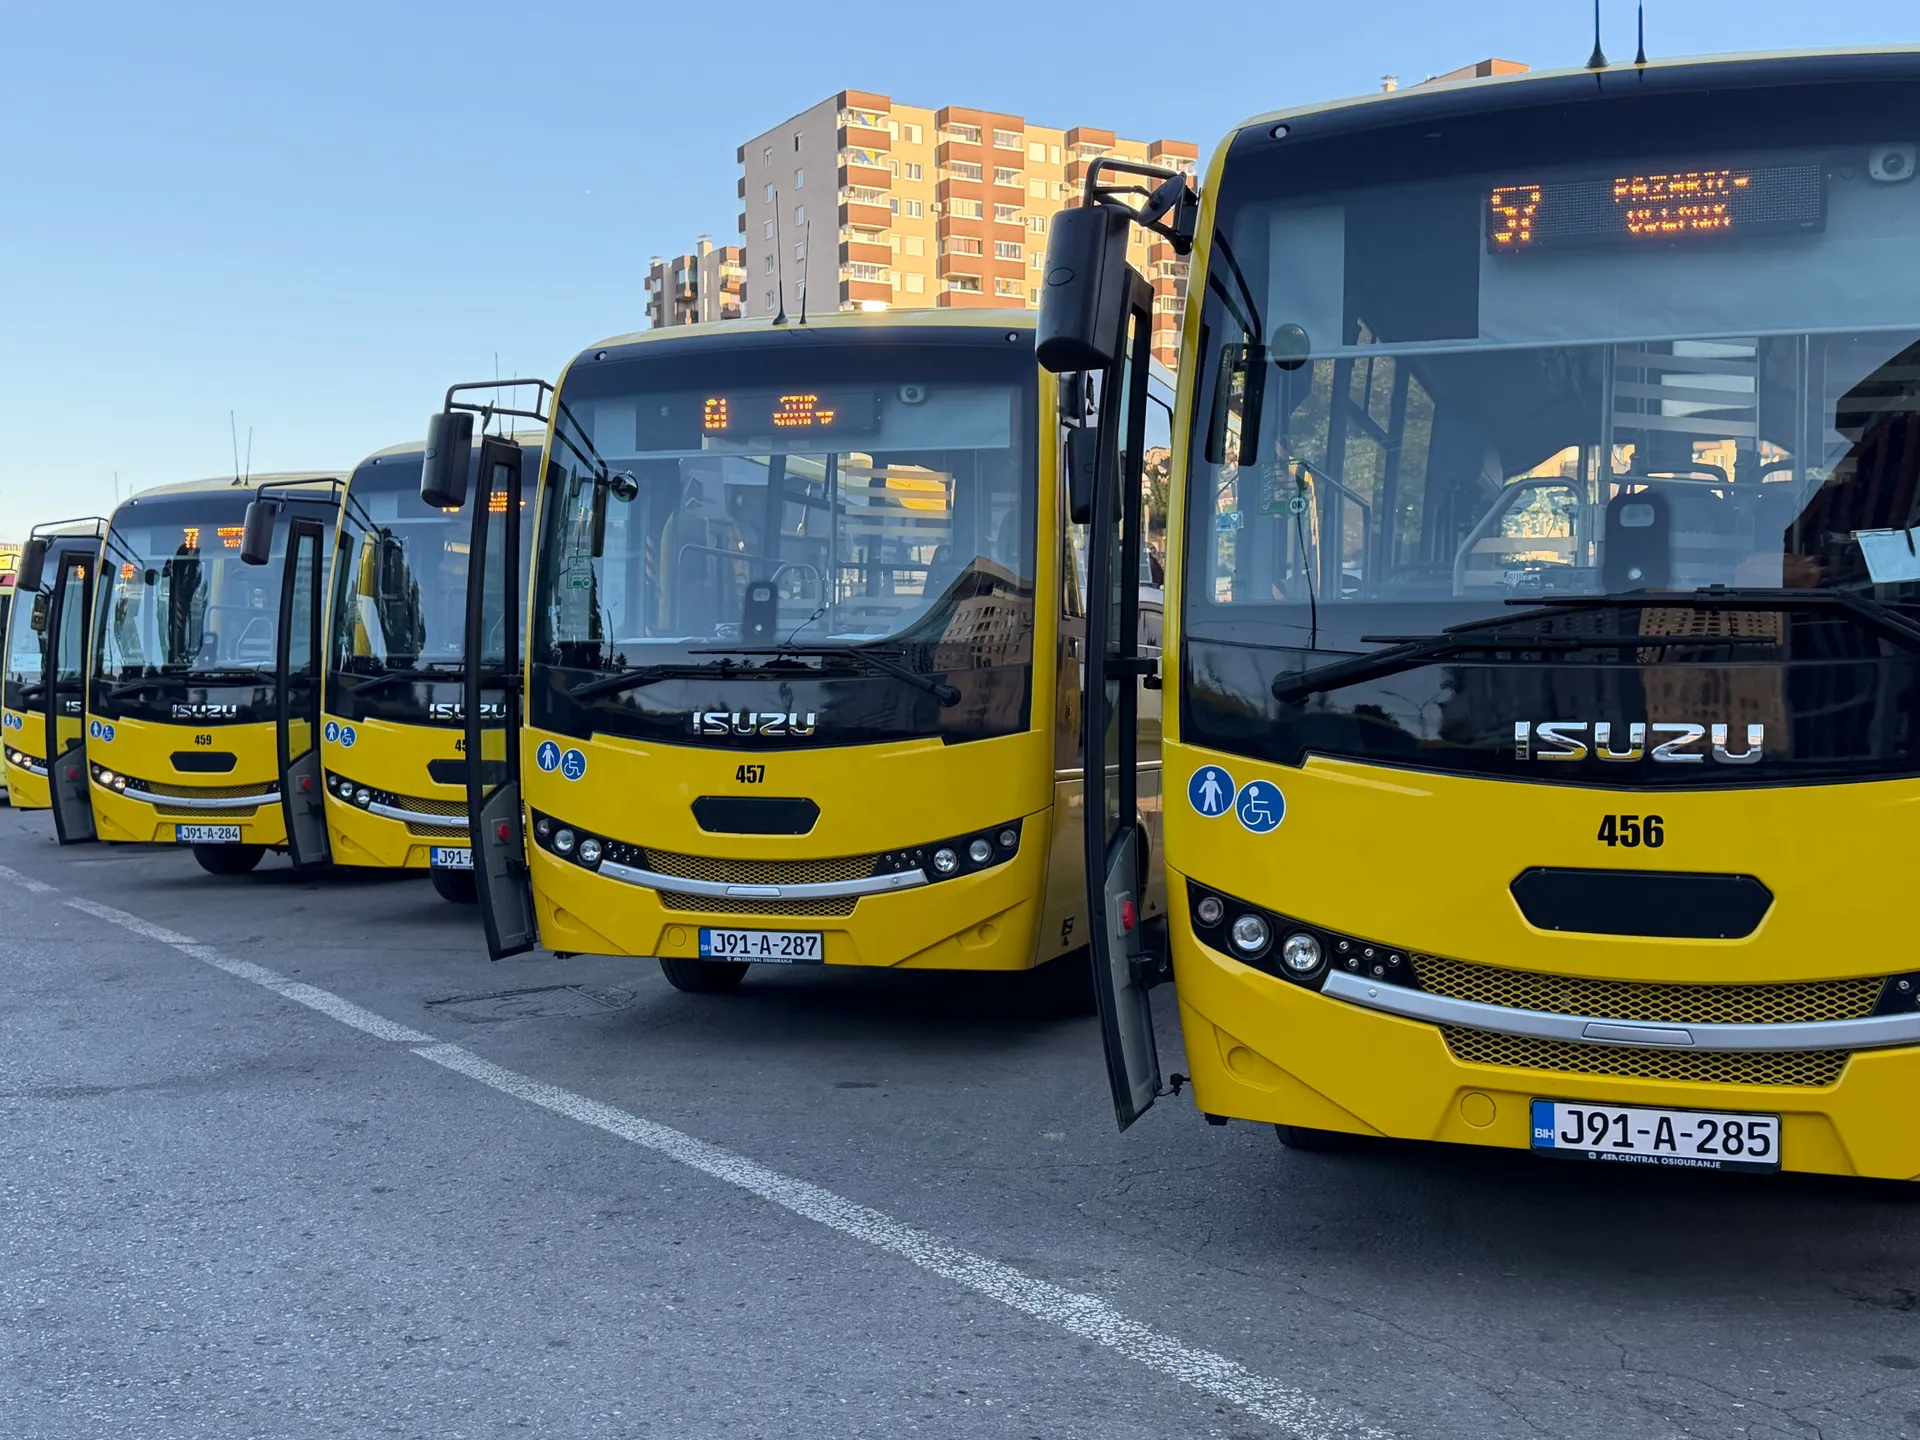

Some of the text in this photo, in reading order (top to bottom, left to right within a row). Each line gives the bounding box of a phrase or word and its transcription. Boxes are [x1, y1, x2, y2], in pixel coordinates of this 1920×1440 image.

[171, 704, 237, 719] ISUZU
[693, 711, 816, 736] ISUZU
[194, 734, 212, 746] 459
[454, 739, 467, 752] 45
[1514, 721, 1764, 764] ISUZU
[735, 764, 766, 783] 457
[183, 826, 238, 839] J91-A-284
[1597, 815, 1665, 848] 456
[713, 932, 818, 957] J91-A-287
[1534, 1127, 1555, 1139] BIH
[1560, 1109, 1771, 1157] J91-A-285
[1618, 1154, 1659, 1165] CENTRAL
[1661, 1157, 1721, 1169] OSIGURANJE
